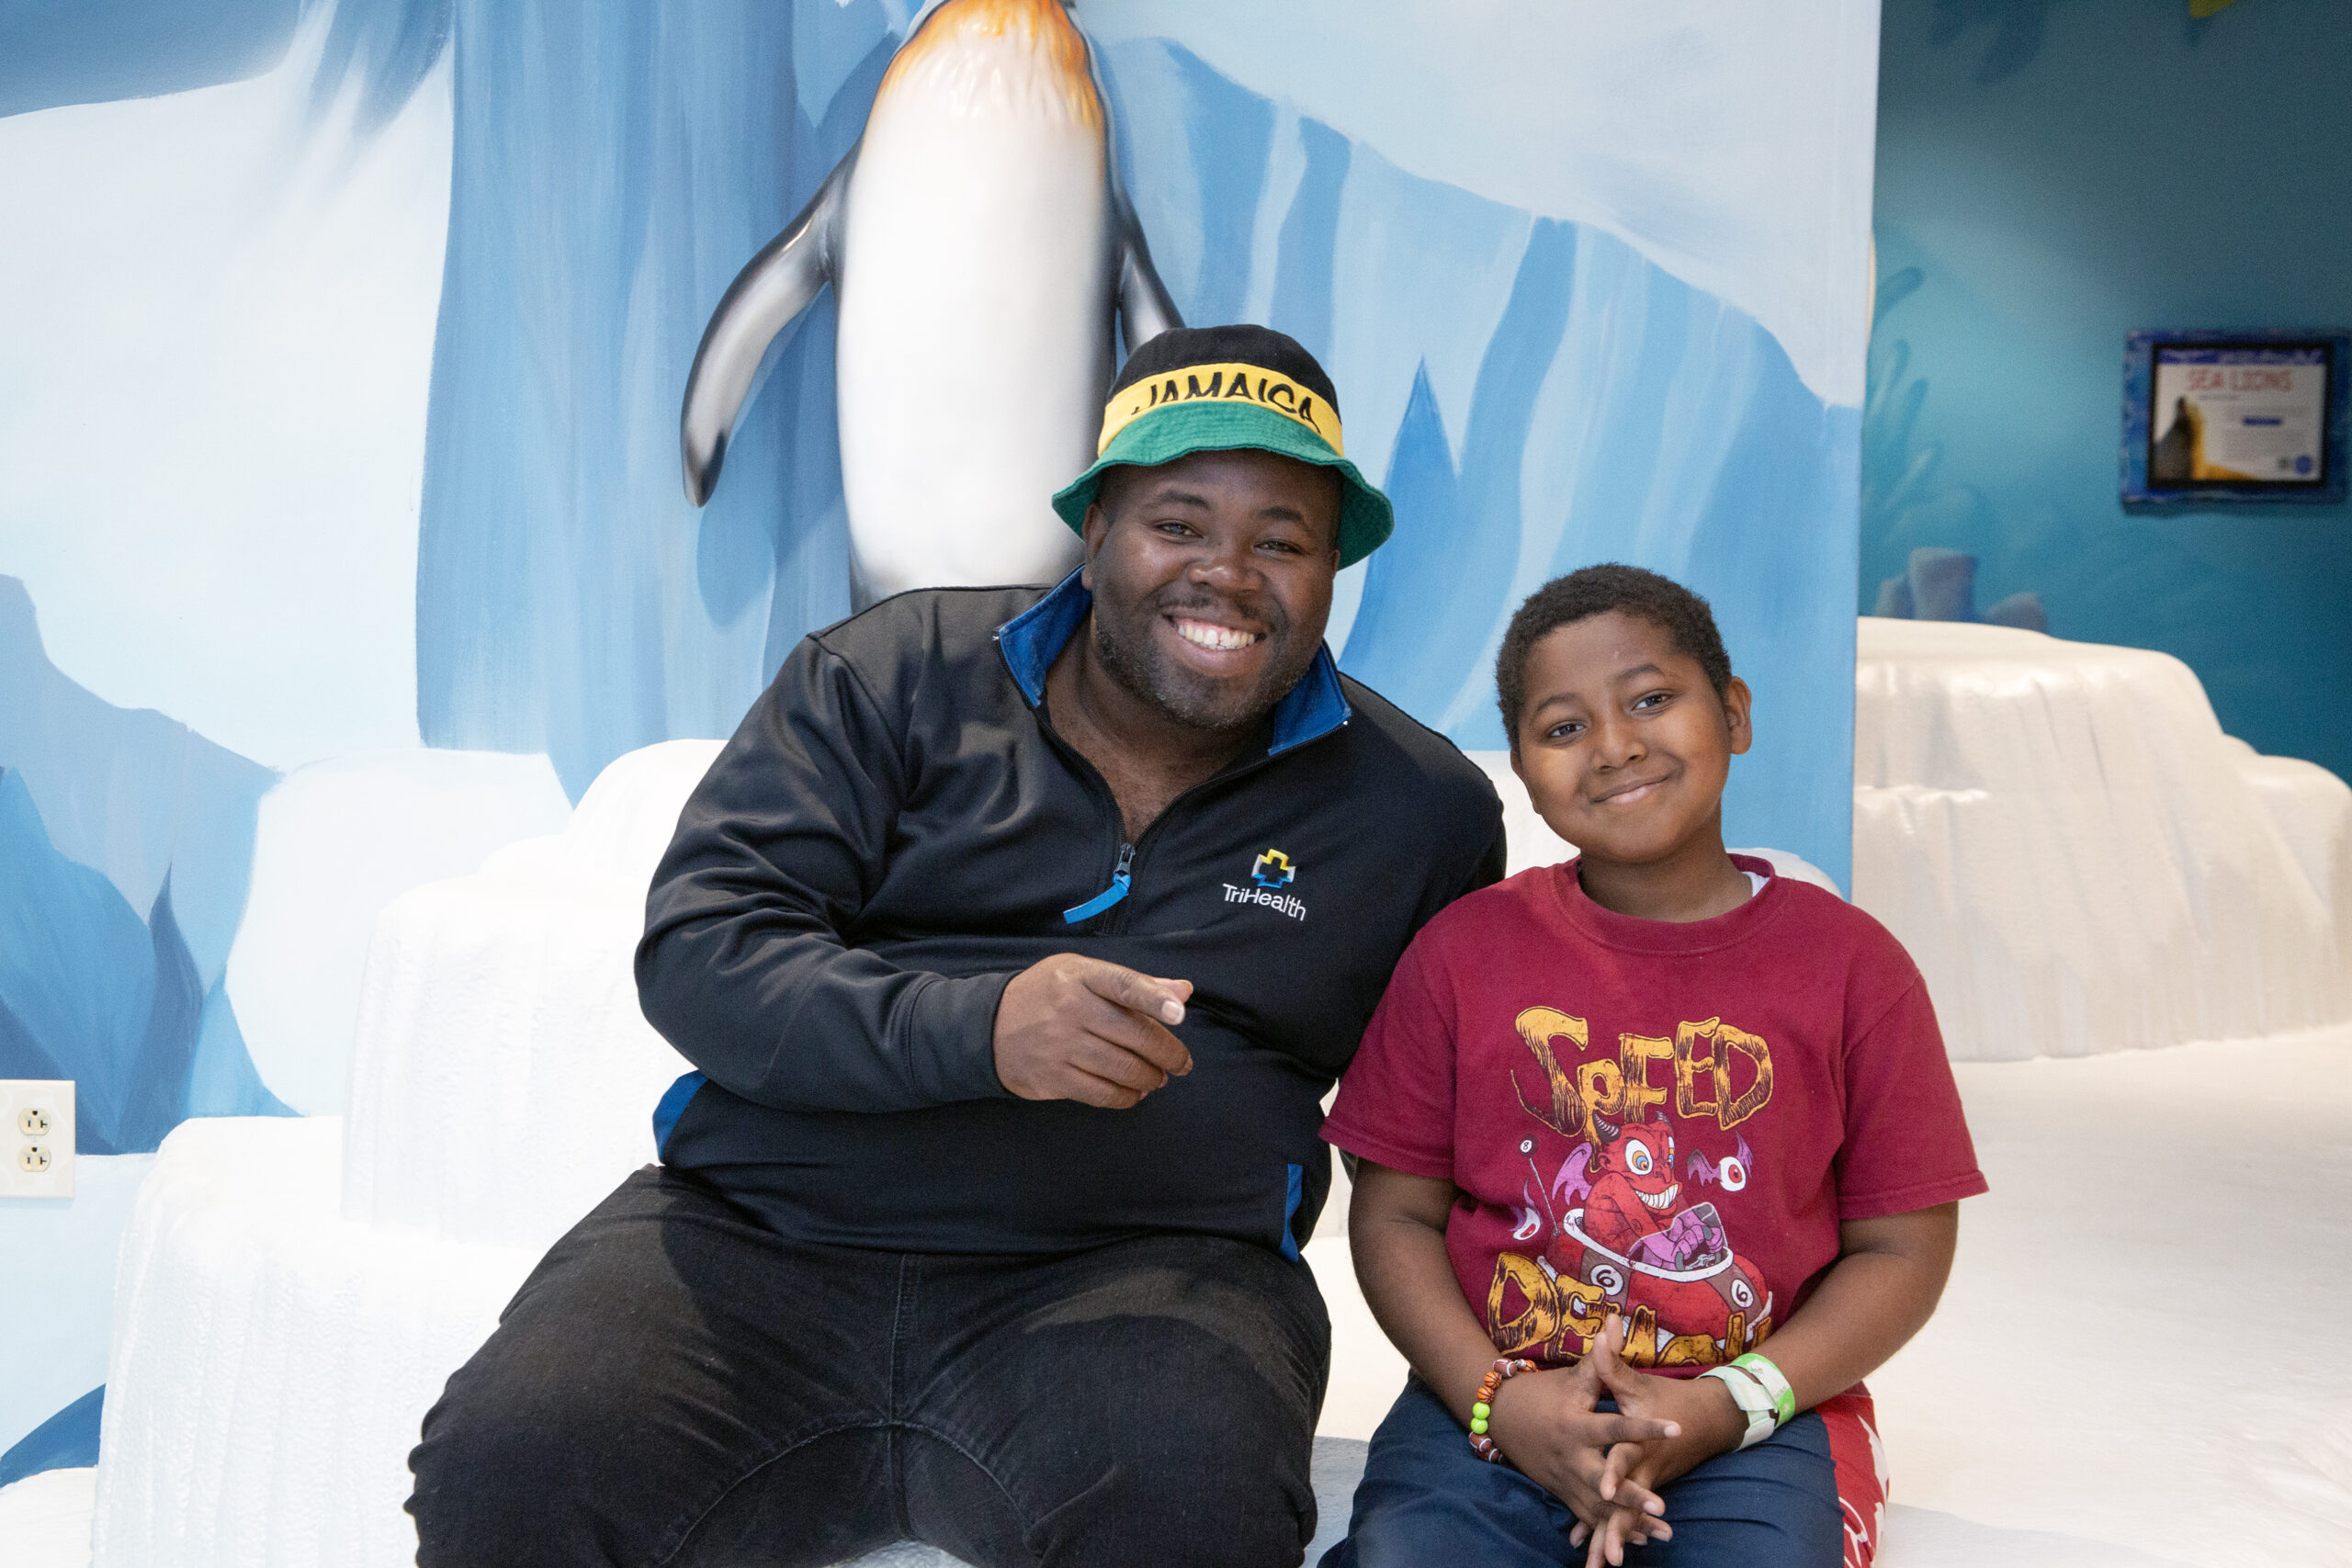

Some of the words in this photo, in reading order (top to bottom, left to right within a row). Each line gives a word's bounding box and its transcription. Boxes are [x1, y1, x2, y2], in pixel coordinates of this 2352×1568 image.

[1131, 371, 1321, 434] JAMAICA
[1222, 883, 1306, 921] TriHealth
[1597, 1269, 1616, 1287] 6
